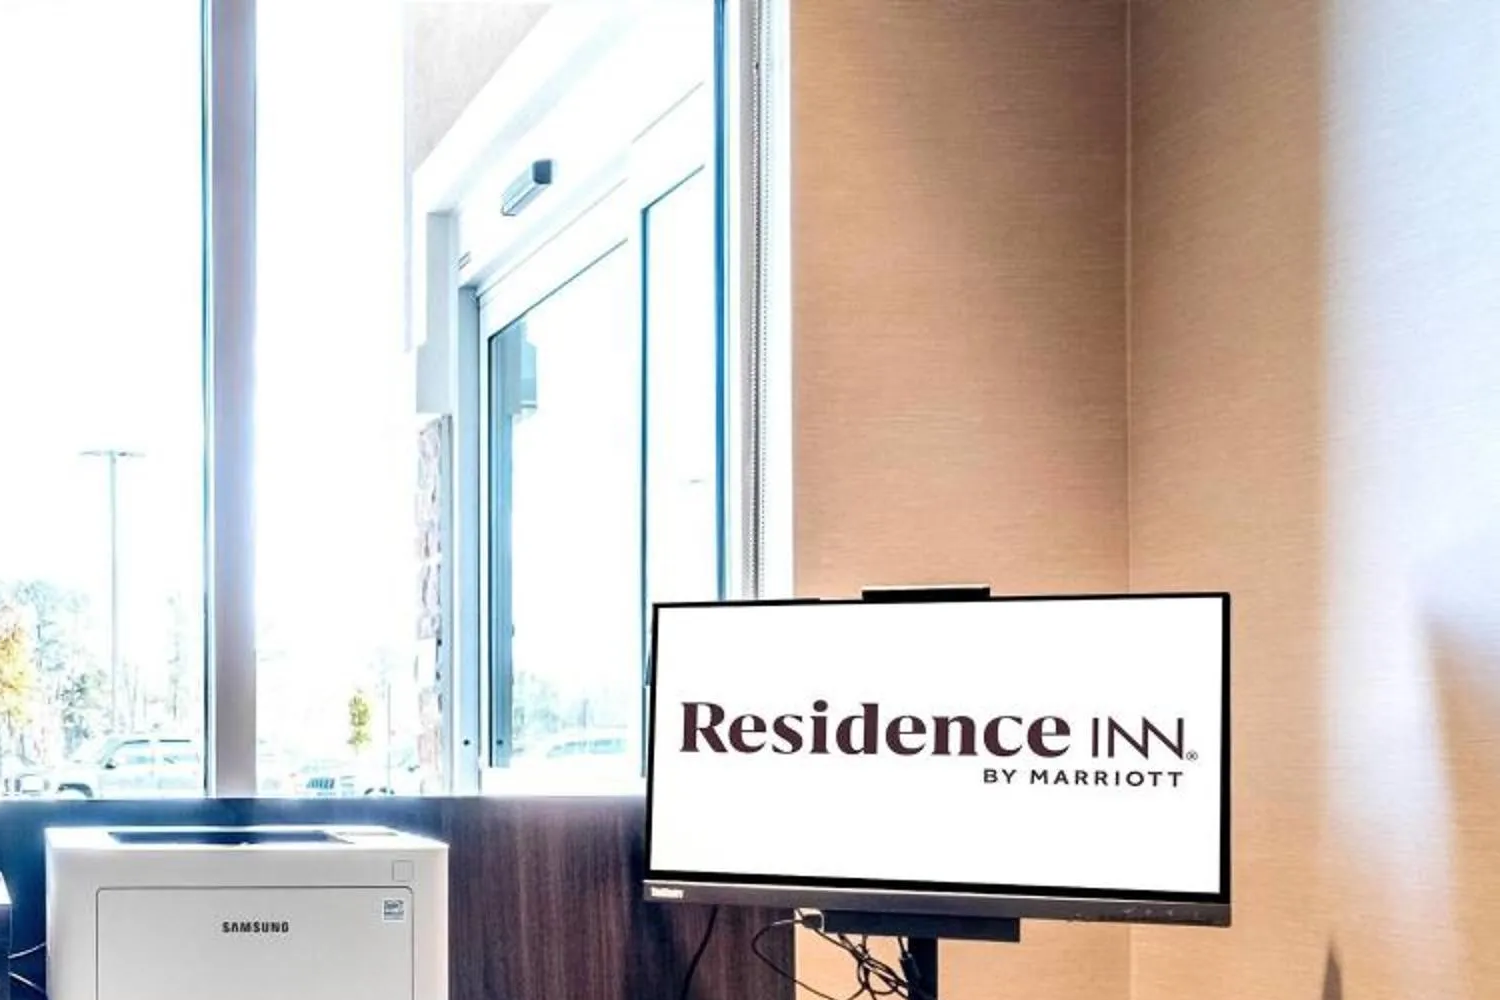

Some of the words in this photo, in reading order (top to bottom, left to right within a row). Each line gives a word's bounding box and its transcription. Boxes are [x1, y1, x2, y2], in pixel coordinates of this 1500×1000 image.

[679, 699, 1071, 759] Residence
[983, 767, 1018, 785] BY
[1029, 768, 1184, 788] MARRIOTT
[221, 920, 290, 934] SAMSUNG
